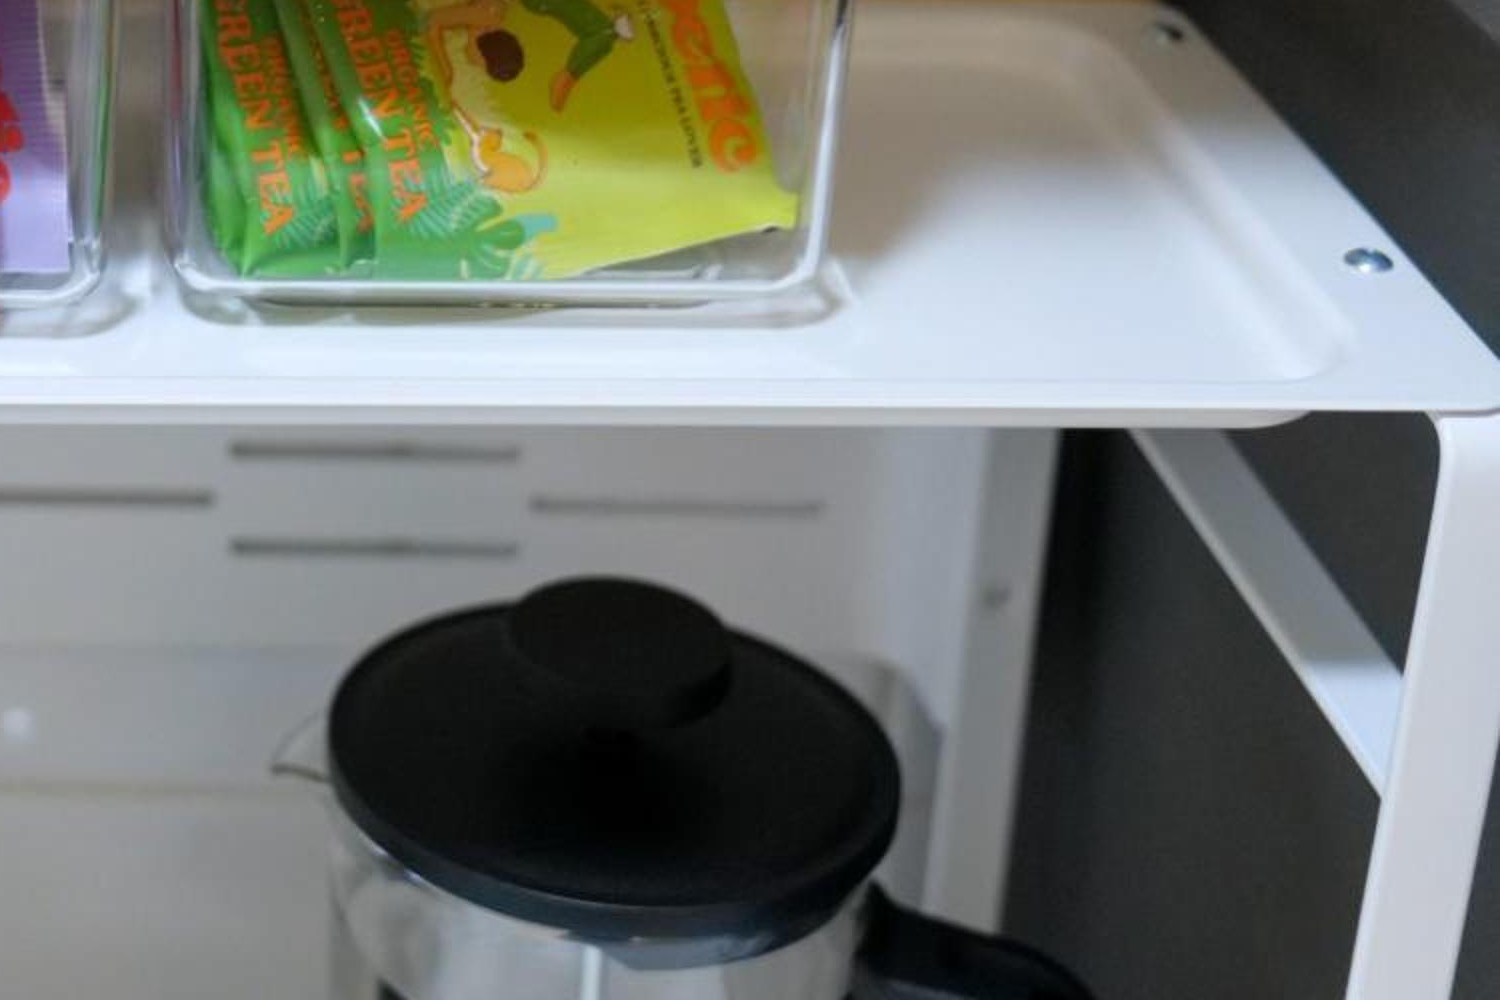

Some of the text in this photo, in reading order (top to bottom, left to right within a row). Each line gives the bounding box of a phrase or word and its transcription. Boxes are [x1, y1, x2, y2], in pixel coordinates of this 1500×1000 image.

[384, 30, 439, 149] ORGANIC
[253, 141, 294, 236] TEA
[383, 128, 429, 221] TEA
